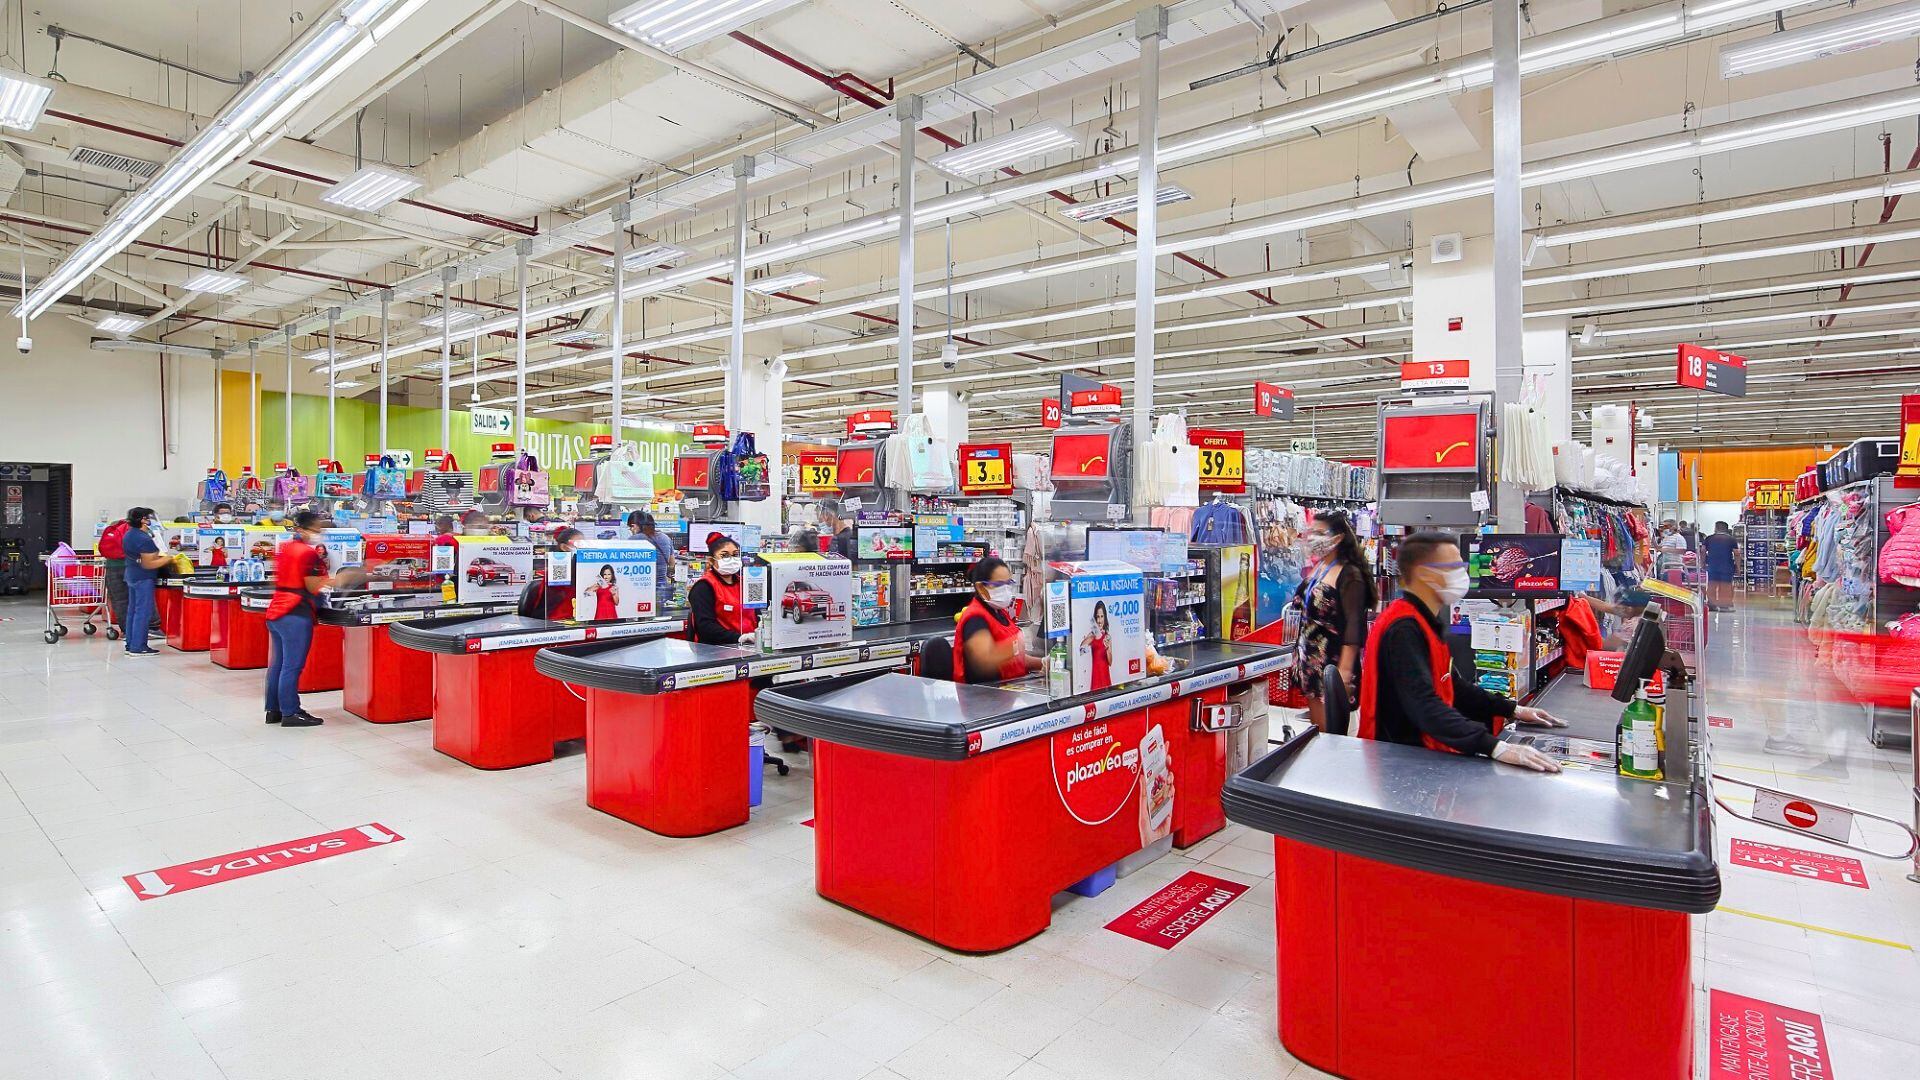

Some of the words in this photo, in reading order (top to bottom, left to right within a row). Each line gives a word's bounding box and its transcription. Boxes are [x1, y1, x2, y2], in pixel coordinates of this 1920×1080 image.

[1428, 363, 1445, 375] 13
[1688, 355, 1702, 377] 18
[1087, 393, 1098, 402] 14
[1261, 391, 1271, 408] 19
[1046, 406, 1059, 421] 20
[474, 414, 497, 429] SALIDA
[1203, 438, 1228, 446] OFERTA
[1101, 581, 1109, 591] AL
[1518, 579, 1554, 589] plazavea
[1086, 708, 1096, 719] oh!
[1071, 731, 1083, 743] Así
[1083, 728, 1093, 739] de
[968, 738, 981, 751] oh!
[1066, 746, 1075, 756] es
[1075, 738, 1104, 754] comprar
[1104, 734, 1113, 744] en
[1066, 742, 1121, 793] plazavea
[189, 838, 347, 876] SALIDA
[1159, 906, 1211, 939] ESPERE
[1199, 887, 1235, 911] AQUÍ
[1741, 1009, 1768, 1050] ACRÍLICO
[1715, 1012, 1742, 1075] MANTÉNGASE
[1775, 1016, 1820, 1059] AQUÍ
[1747, 1050, 1769, 1062] AL
[1788, 1053, 1824, 1080] ERE
